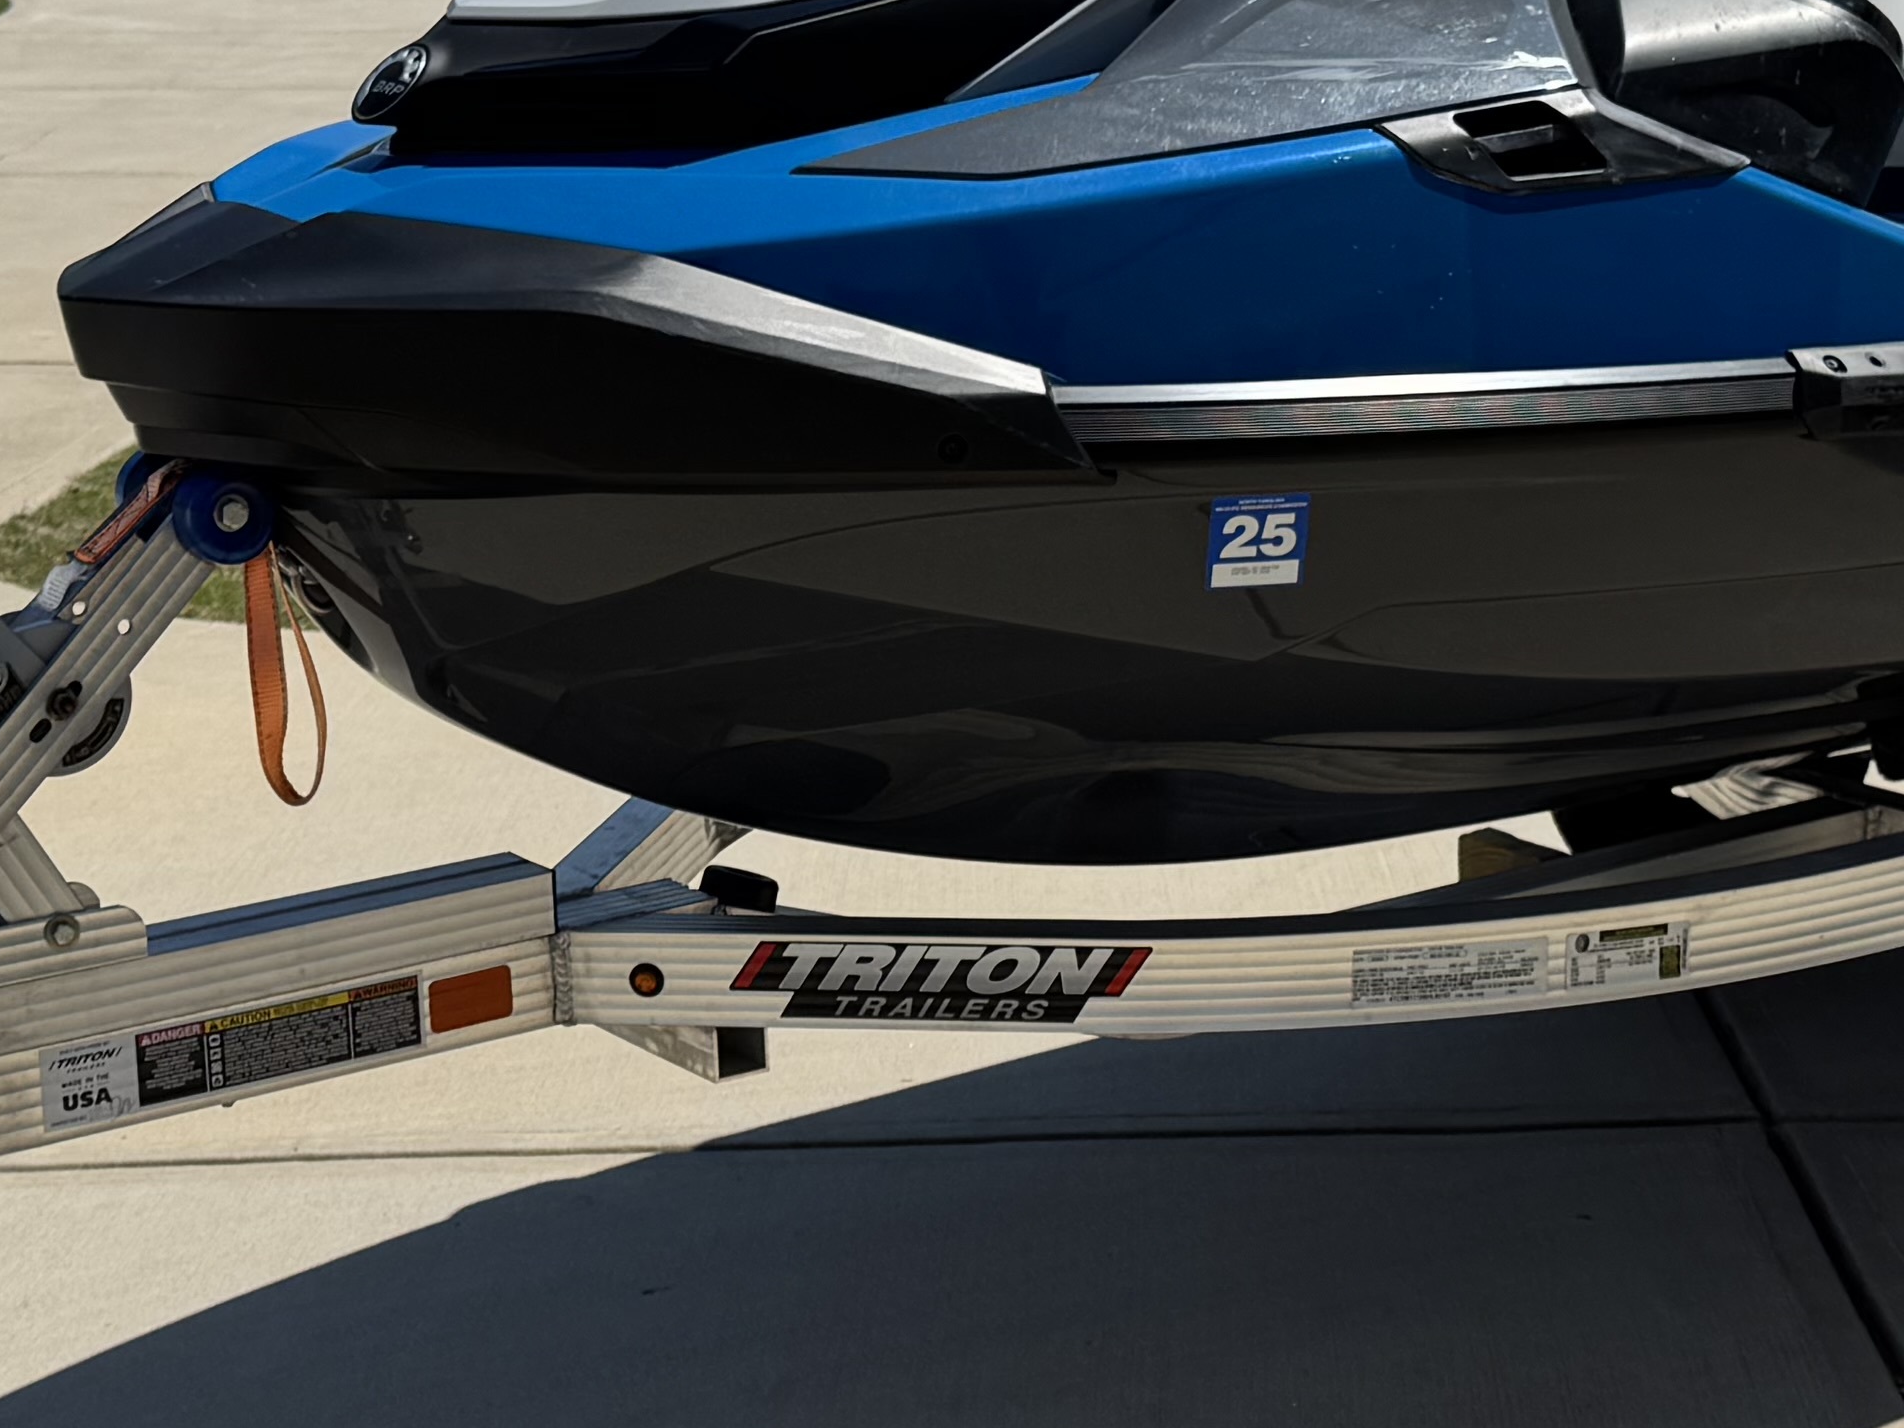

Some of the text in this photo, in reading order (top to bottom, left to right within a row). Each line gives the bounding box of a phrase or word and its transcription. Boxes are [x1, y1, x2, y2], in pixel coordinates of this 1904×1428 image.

[372, 80, 405, 95] BRP
[1219, 512, 1297, 559] 25
[779, 943, 1114, 995] TRITON
[220, 1009, 271, 1028] CAUTION
[834, 995, 1050, 1021] TRAILERS
[152, 1024, 201, 1043] DANGER
[57, 1048, 114, 1070] TRITON
[61, 1072, 109, 1089] MADE IN THE
[62, 1087, 113, 1111] USA
